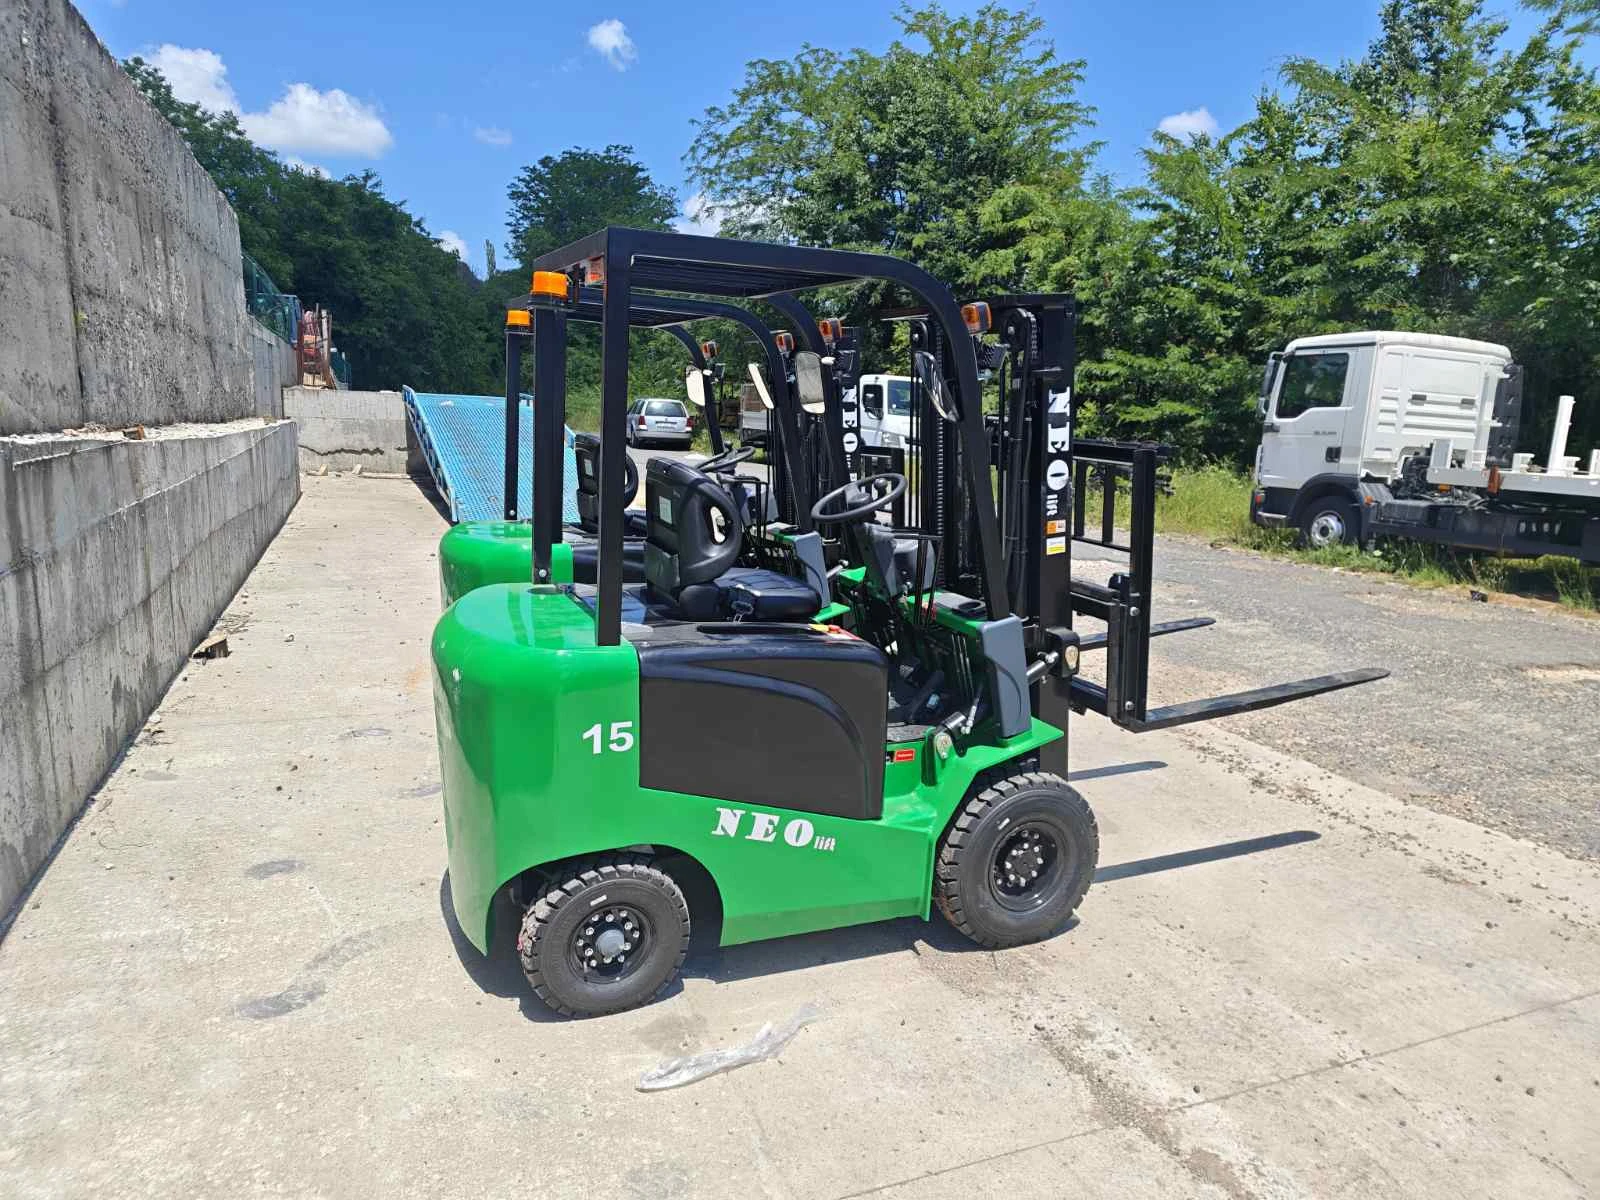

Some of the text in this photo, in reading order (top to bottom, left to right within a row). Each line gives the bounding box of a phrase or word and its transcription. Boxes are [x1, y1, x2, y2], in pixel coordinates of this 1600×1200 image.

[842, 385, 858, 453] NEO
[1046, 386, 1070, 491] NEO
[582, 720, 634, 754] 15
[711, 807, 814, 847] NEO
